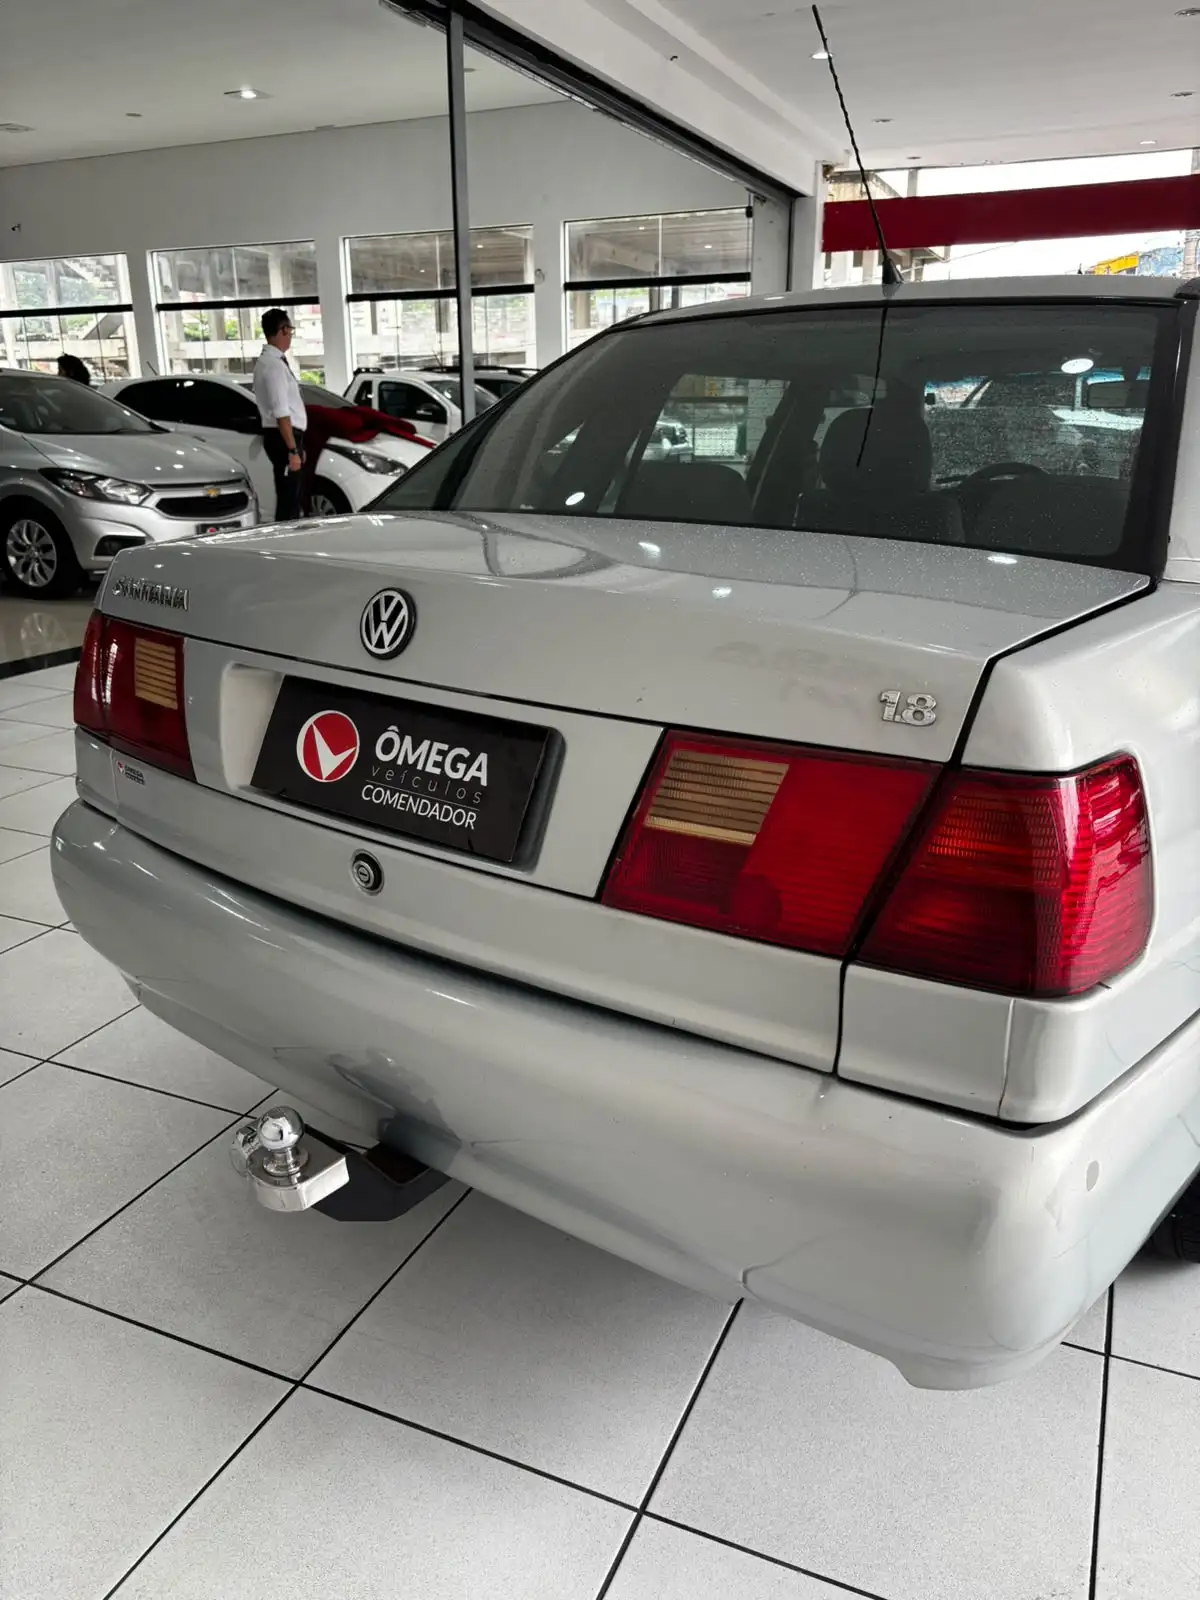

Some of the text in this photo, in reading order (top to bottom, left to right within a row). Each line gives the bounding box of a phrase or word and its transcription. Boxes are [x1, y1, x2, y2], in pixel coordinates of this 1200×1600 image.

[362, 589, 409, 654] VW
[375, 725, 488, 786] ÔMEGA
[361, 784, 476, 829] COMENDADOR
[371, 764, 482, 804] veículos
